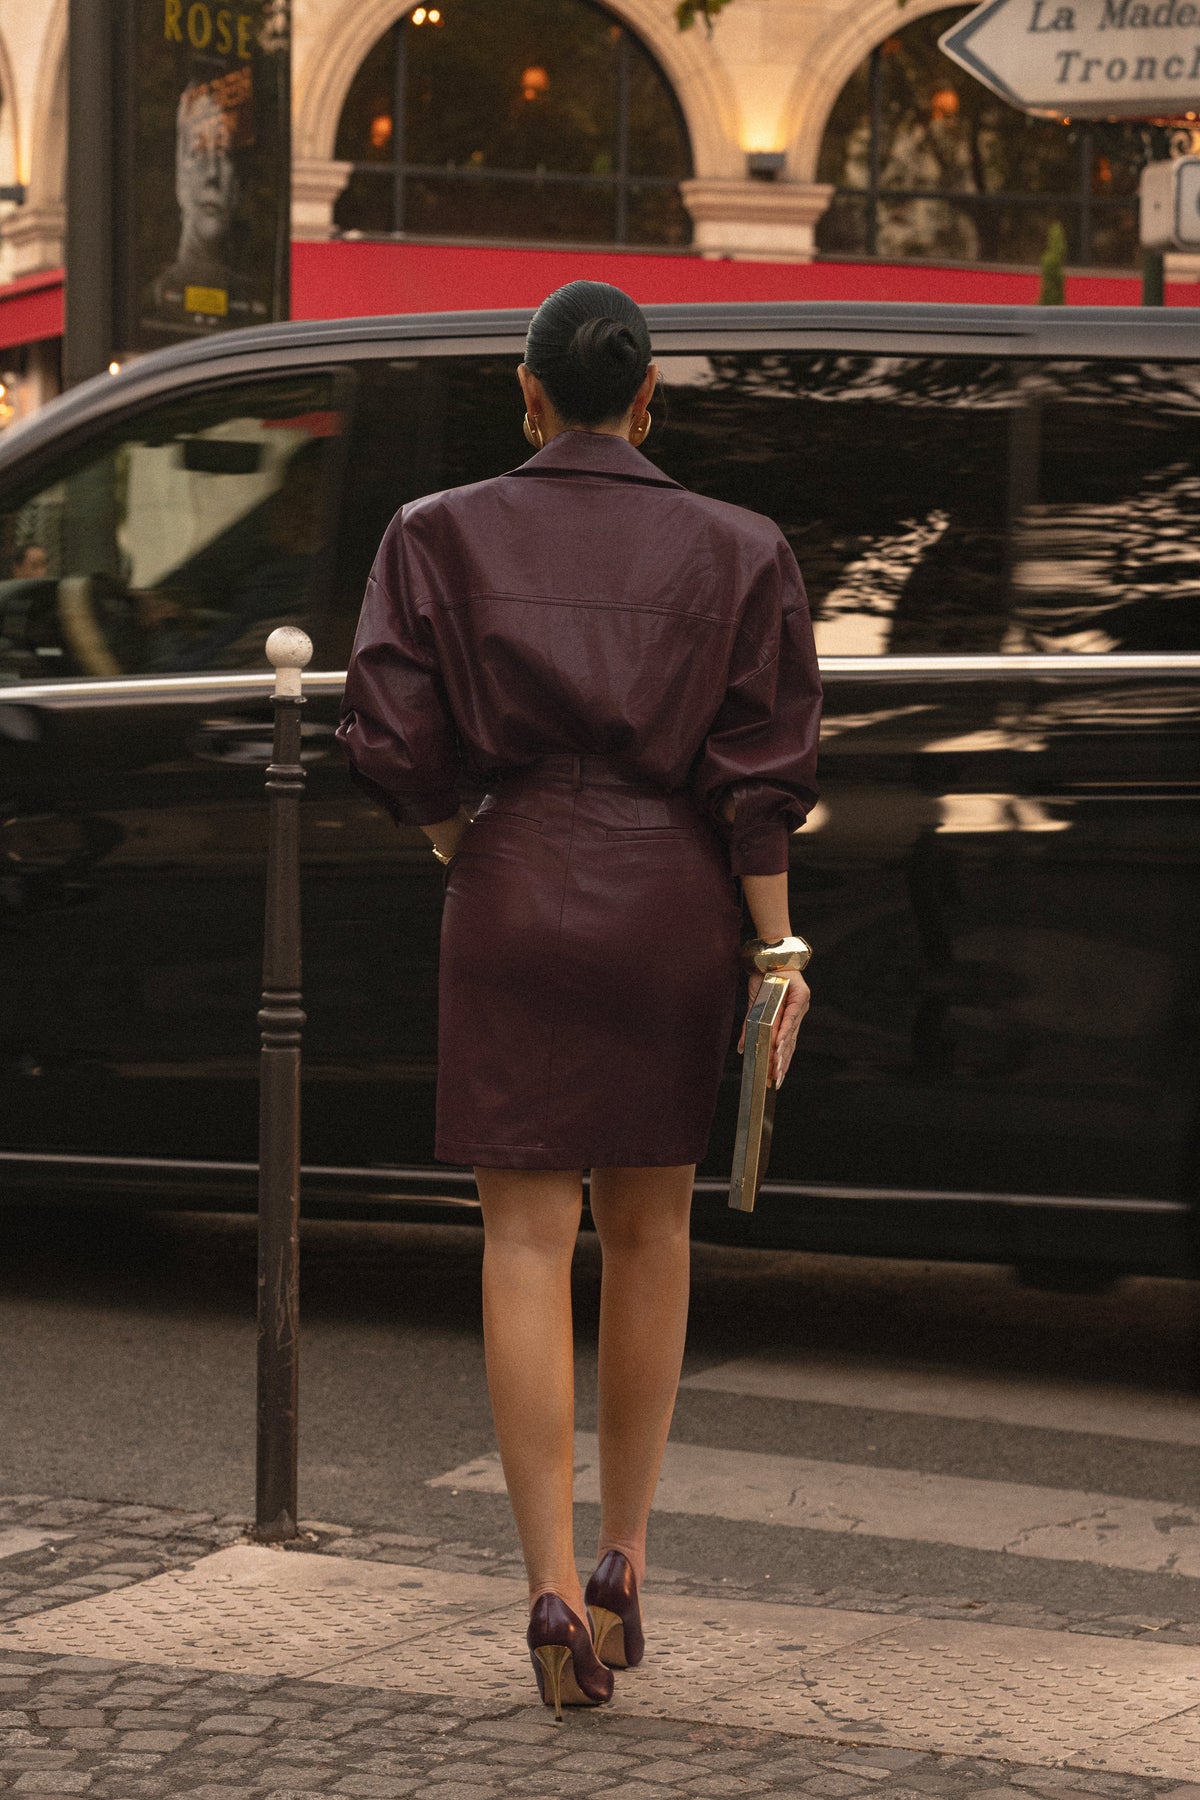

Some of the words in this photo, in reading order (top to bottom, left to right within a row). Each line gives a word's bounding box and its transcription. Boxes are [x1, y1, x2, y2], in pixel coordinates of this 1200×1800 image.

[164, 0, 252, 58] ROSE
[1027, 0, 1075, 33] La
[1098, 0, 1200, 30] Made
